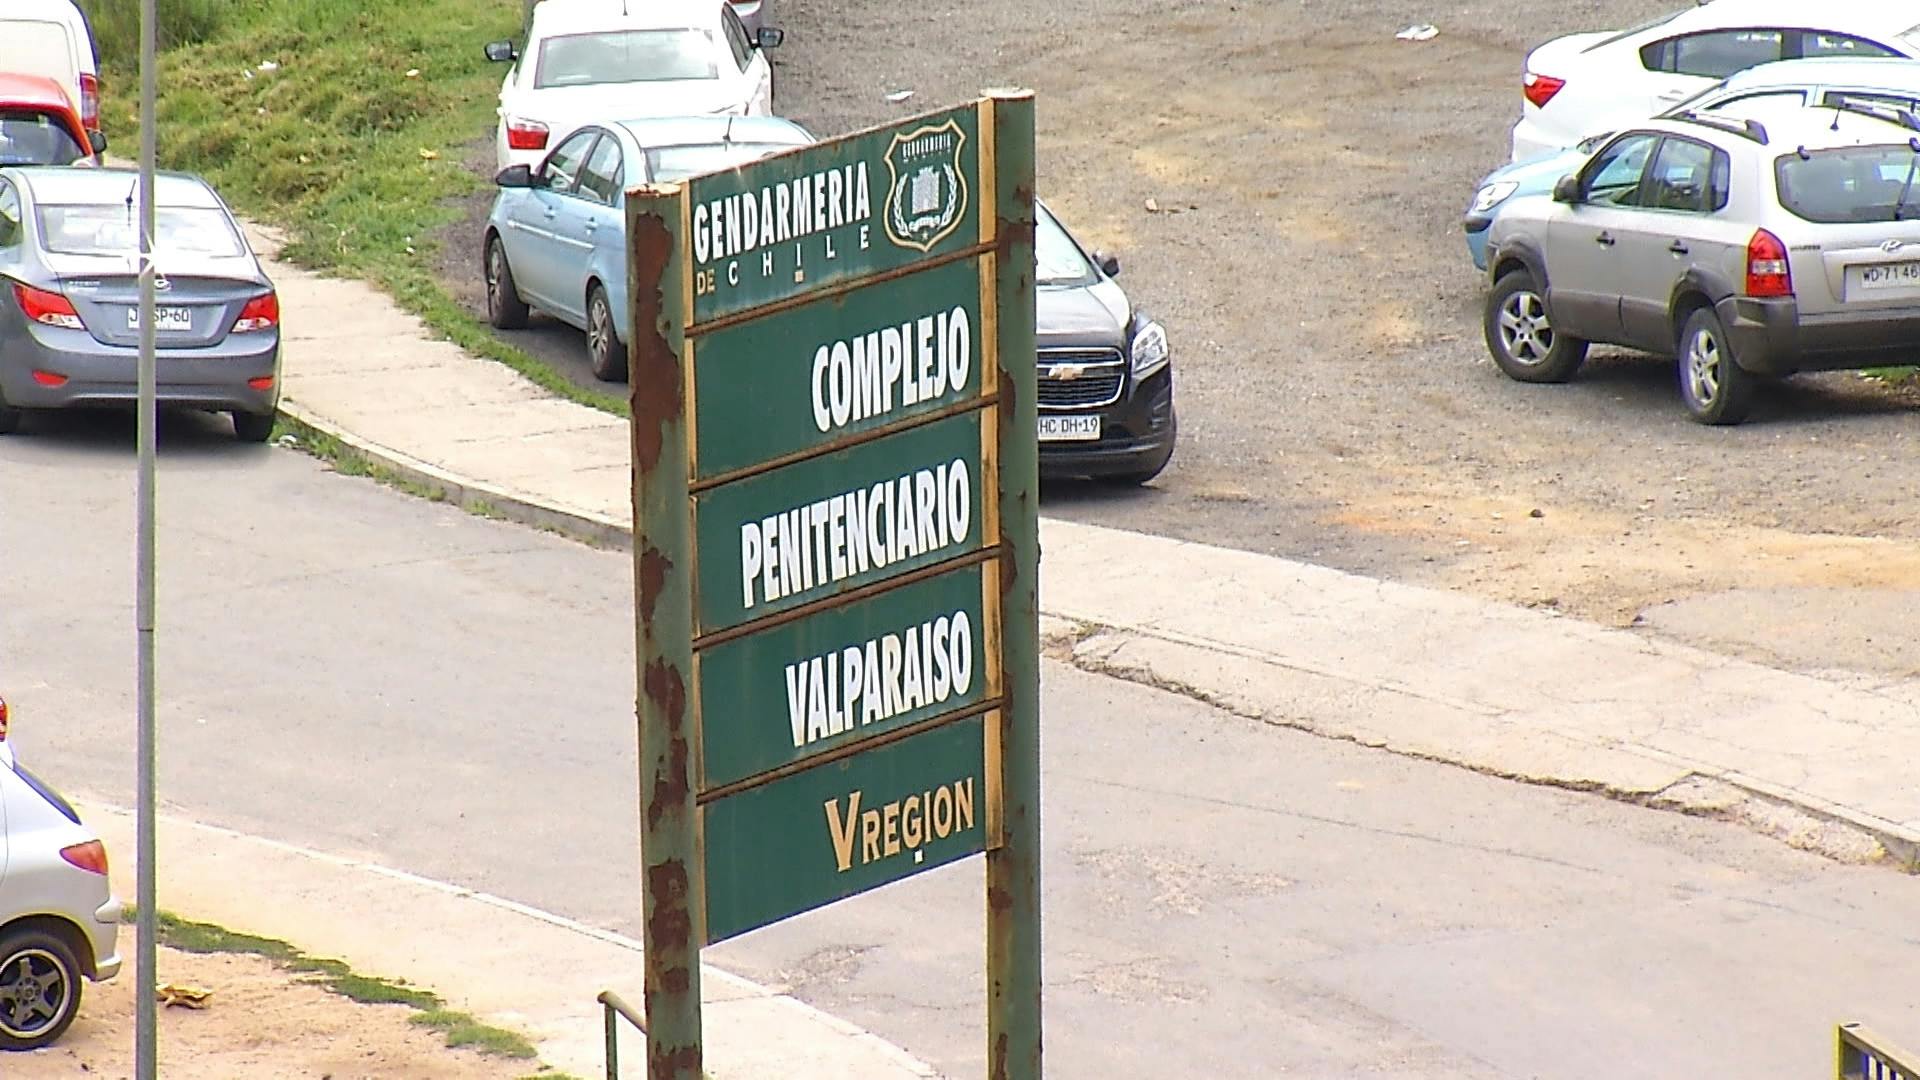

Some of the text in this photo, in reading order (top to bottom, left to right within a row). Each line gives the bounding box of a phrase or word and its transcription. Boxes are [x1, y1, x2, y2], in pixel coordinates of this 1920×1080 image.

[693, 161, 871, 264] GENDARMERIA
[696, 268, 715, 295] DE
[812, 305, 970, 433] COMPLEJO
[741, 458, 970, 609] PENITENCIARIO
[785, 610, 972, 748] VALPARAISO
[824, 777, 974, 872] V REGION
